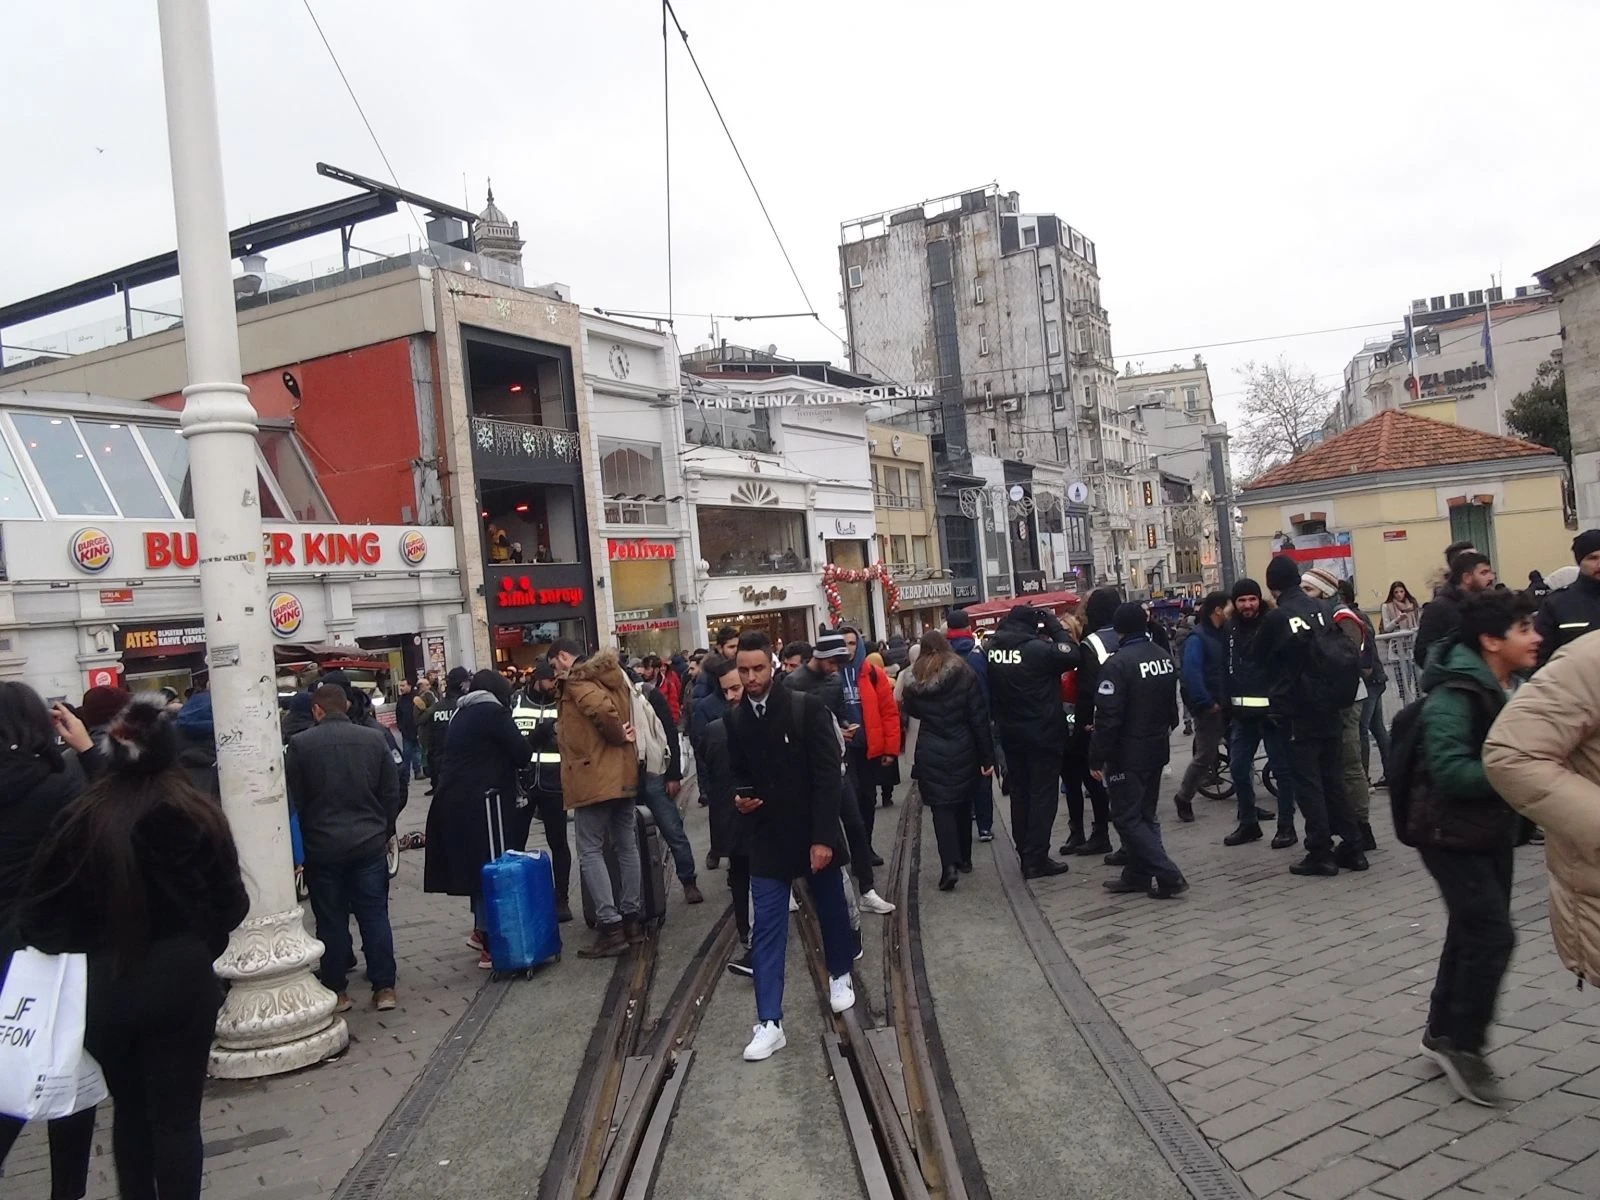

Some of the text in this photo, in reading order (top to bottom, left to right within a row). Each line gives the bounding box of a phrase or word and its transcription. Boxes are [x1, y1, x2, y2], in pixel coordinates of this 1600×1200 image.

[77, 536, 108, 552] BURGER
[302, 532, 381, 566] KING
[407, 542, 426, 557] KING
[608, 539, 675, 561] Pehlivan
[79, 544, 110, 564] KING
[899, 581, 952, 600] KEBAP DÜNYASI
[273, 600, 297, 616] BURGER
[275, 607, 301, 627] KING
[158, 637, 181, 646] KAHVE
